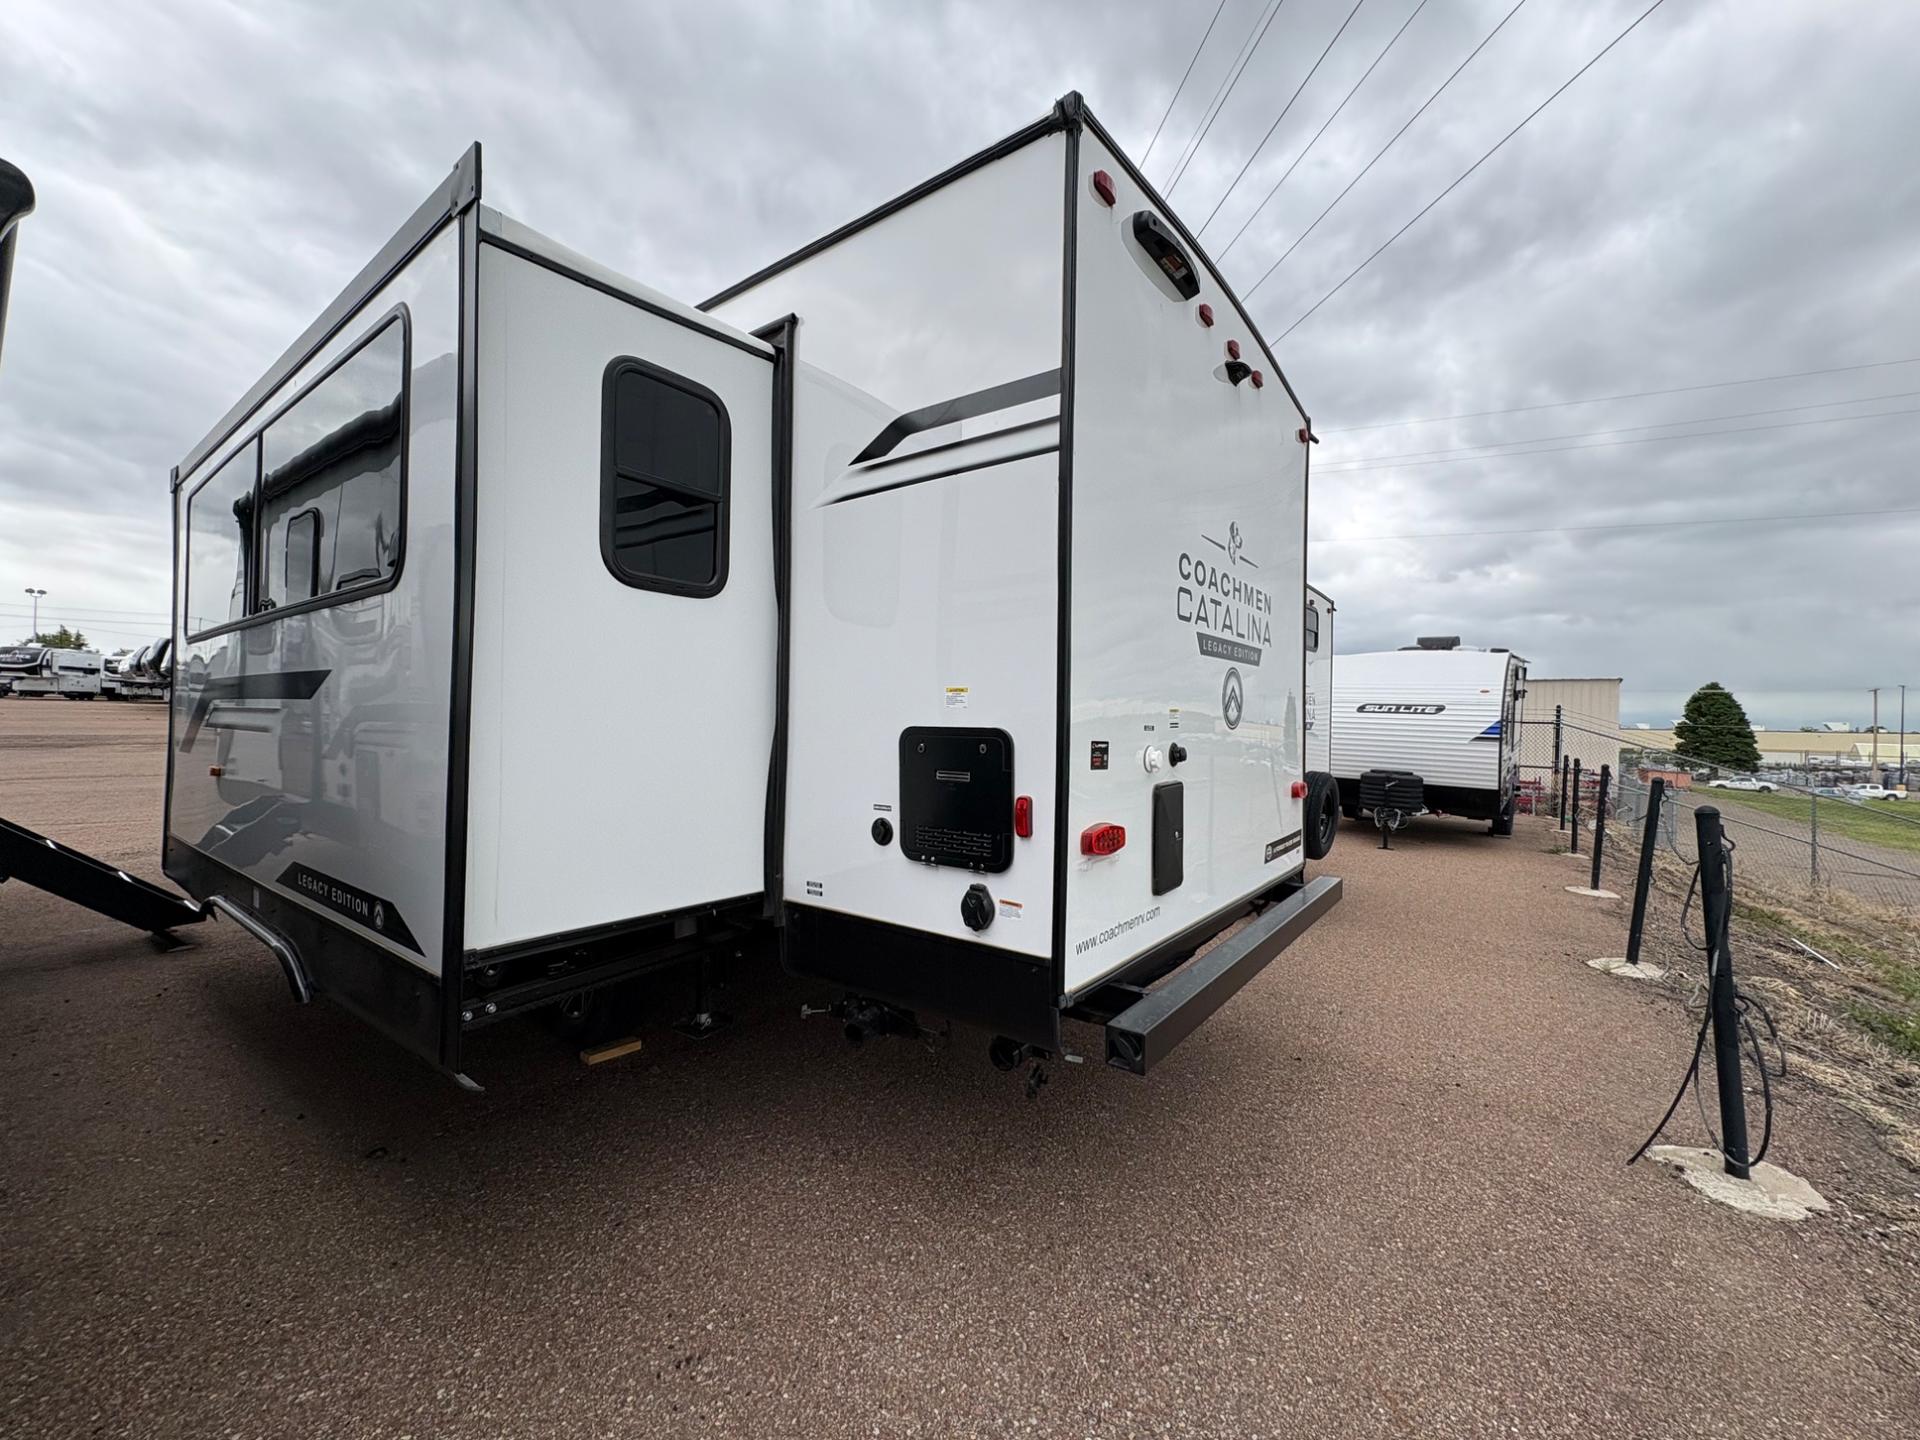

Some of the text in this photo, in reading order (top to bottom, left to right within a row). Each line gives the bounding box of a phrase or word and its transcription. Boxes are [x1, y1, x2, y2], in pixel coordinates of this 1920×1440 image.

[1178, 552, 1272, 616] COACHMEN
[1177, 586, 1272, 648] CATALINA
[1202, 639, 1259, 662] LEGACY EDITION
[1399, 705, 1438, 713] LITE
[297, 871, 369, 917] LEGACY EDITION
[1075, 905, 1161, 956] www.coachmenrv.com
